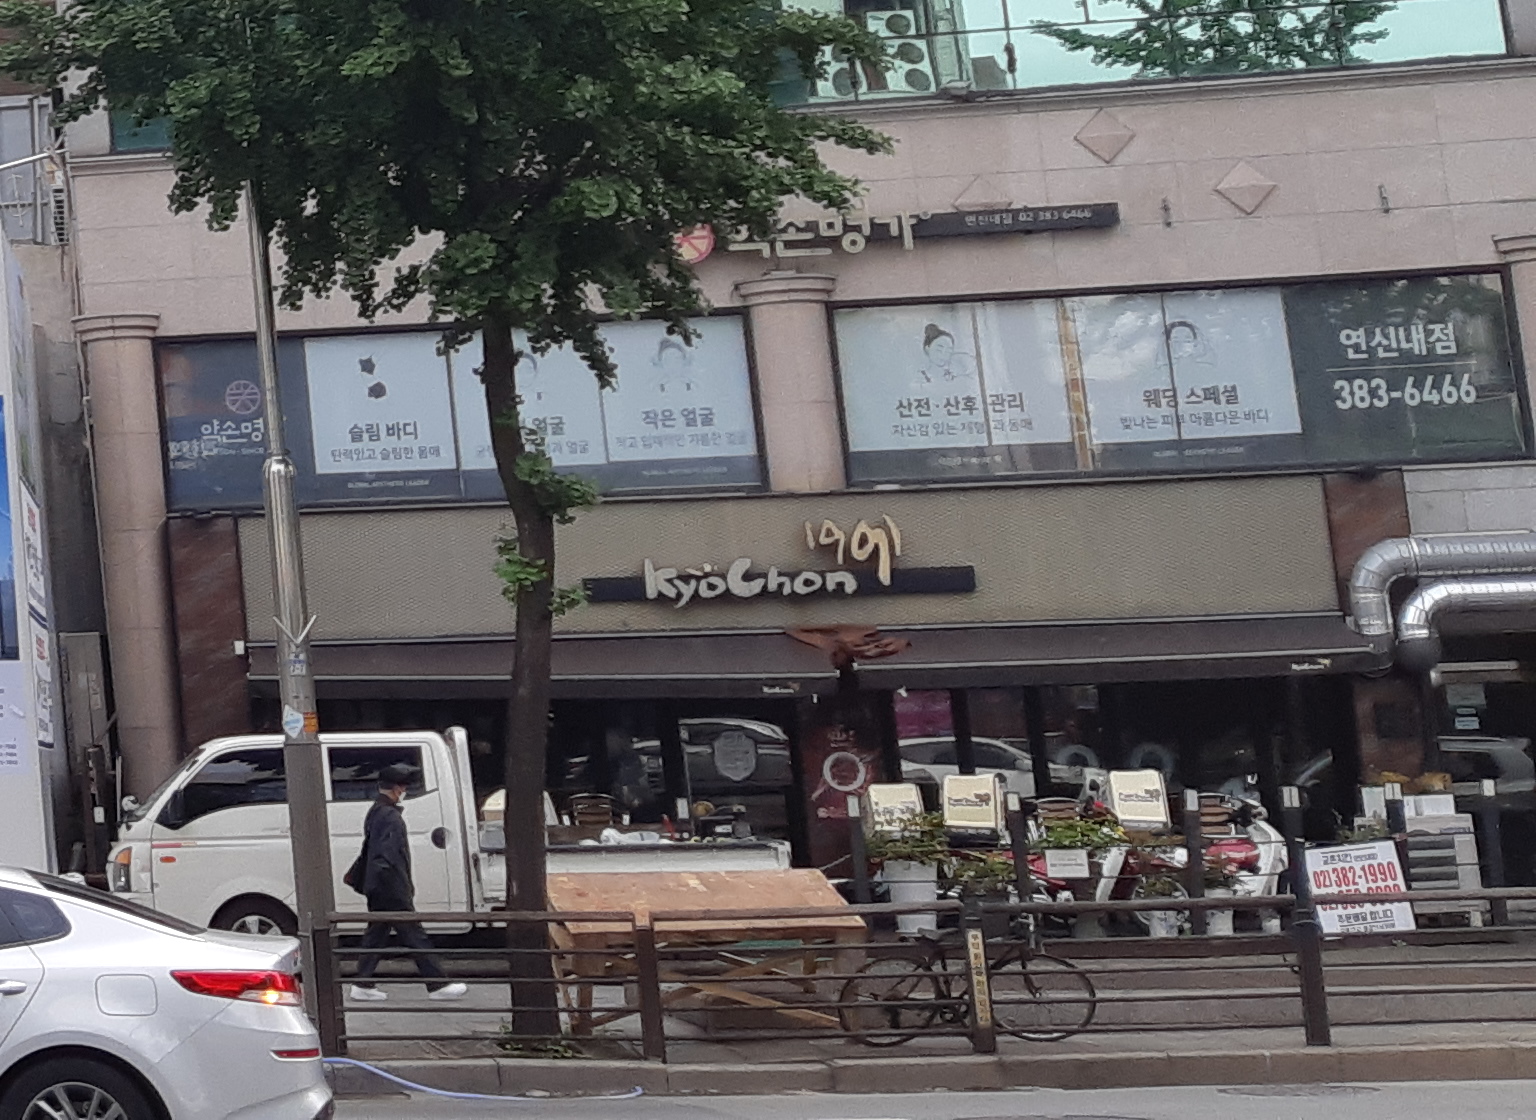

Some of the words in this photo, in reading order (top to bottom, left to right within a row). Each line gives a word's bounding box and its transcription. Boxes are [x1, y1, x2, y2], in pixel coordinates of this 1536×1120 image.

[1339, 321, 1458, 359] 연신내점
[989, 392, 1024, 414] 관리
[1142, 388, 1178, 410] 웨딩
[1185, 384, 1240, 406] 스페셜
[1334, 373, 1477, 410] 383-6466
[200, 416, 278, 443] 약손명
[641, 408, 677, 429] 작은
[680, 407, 716, 428] 얼굴
[347, 422, 380, 443] 슬림
[386, 420, 419, 441] 바디
